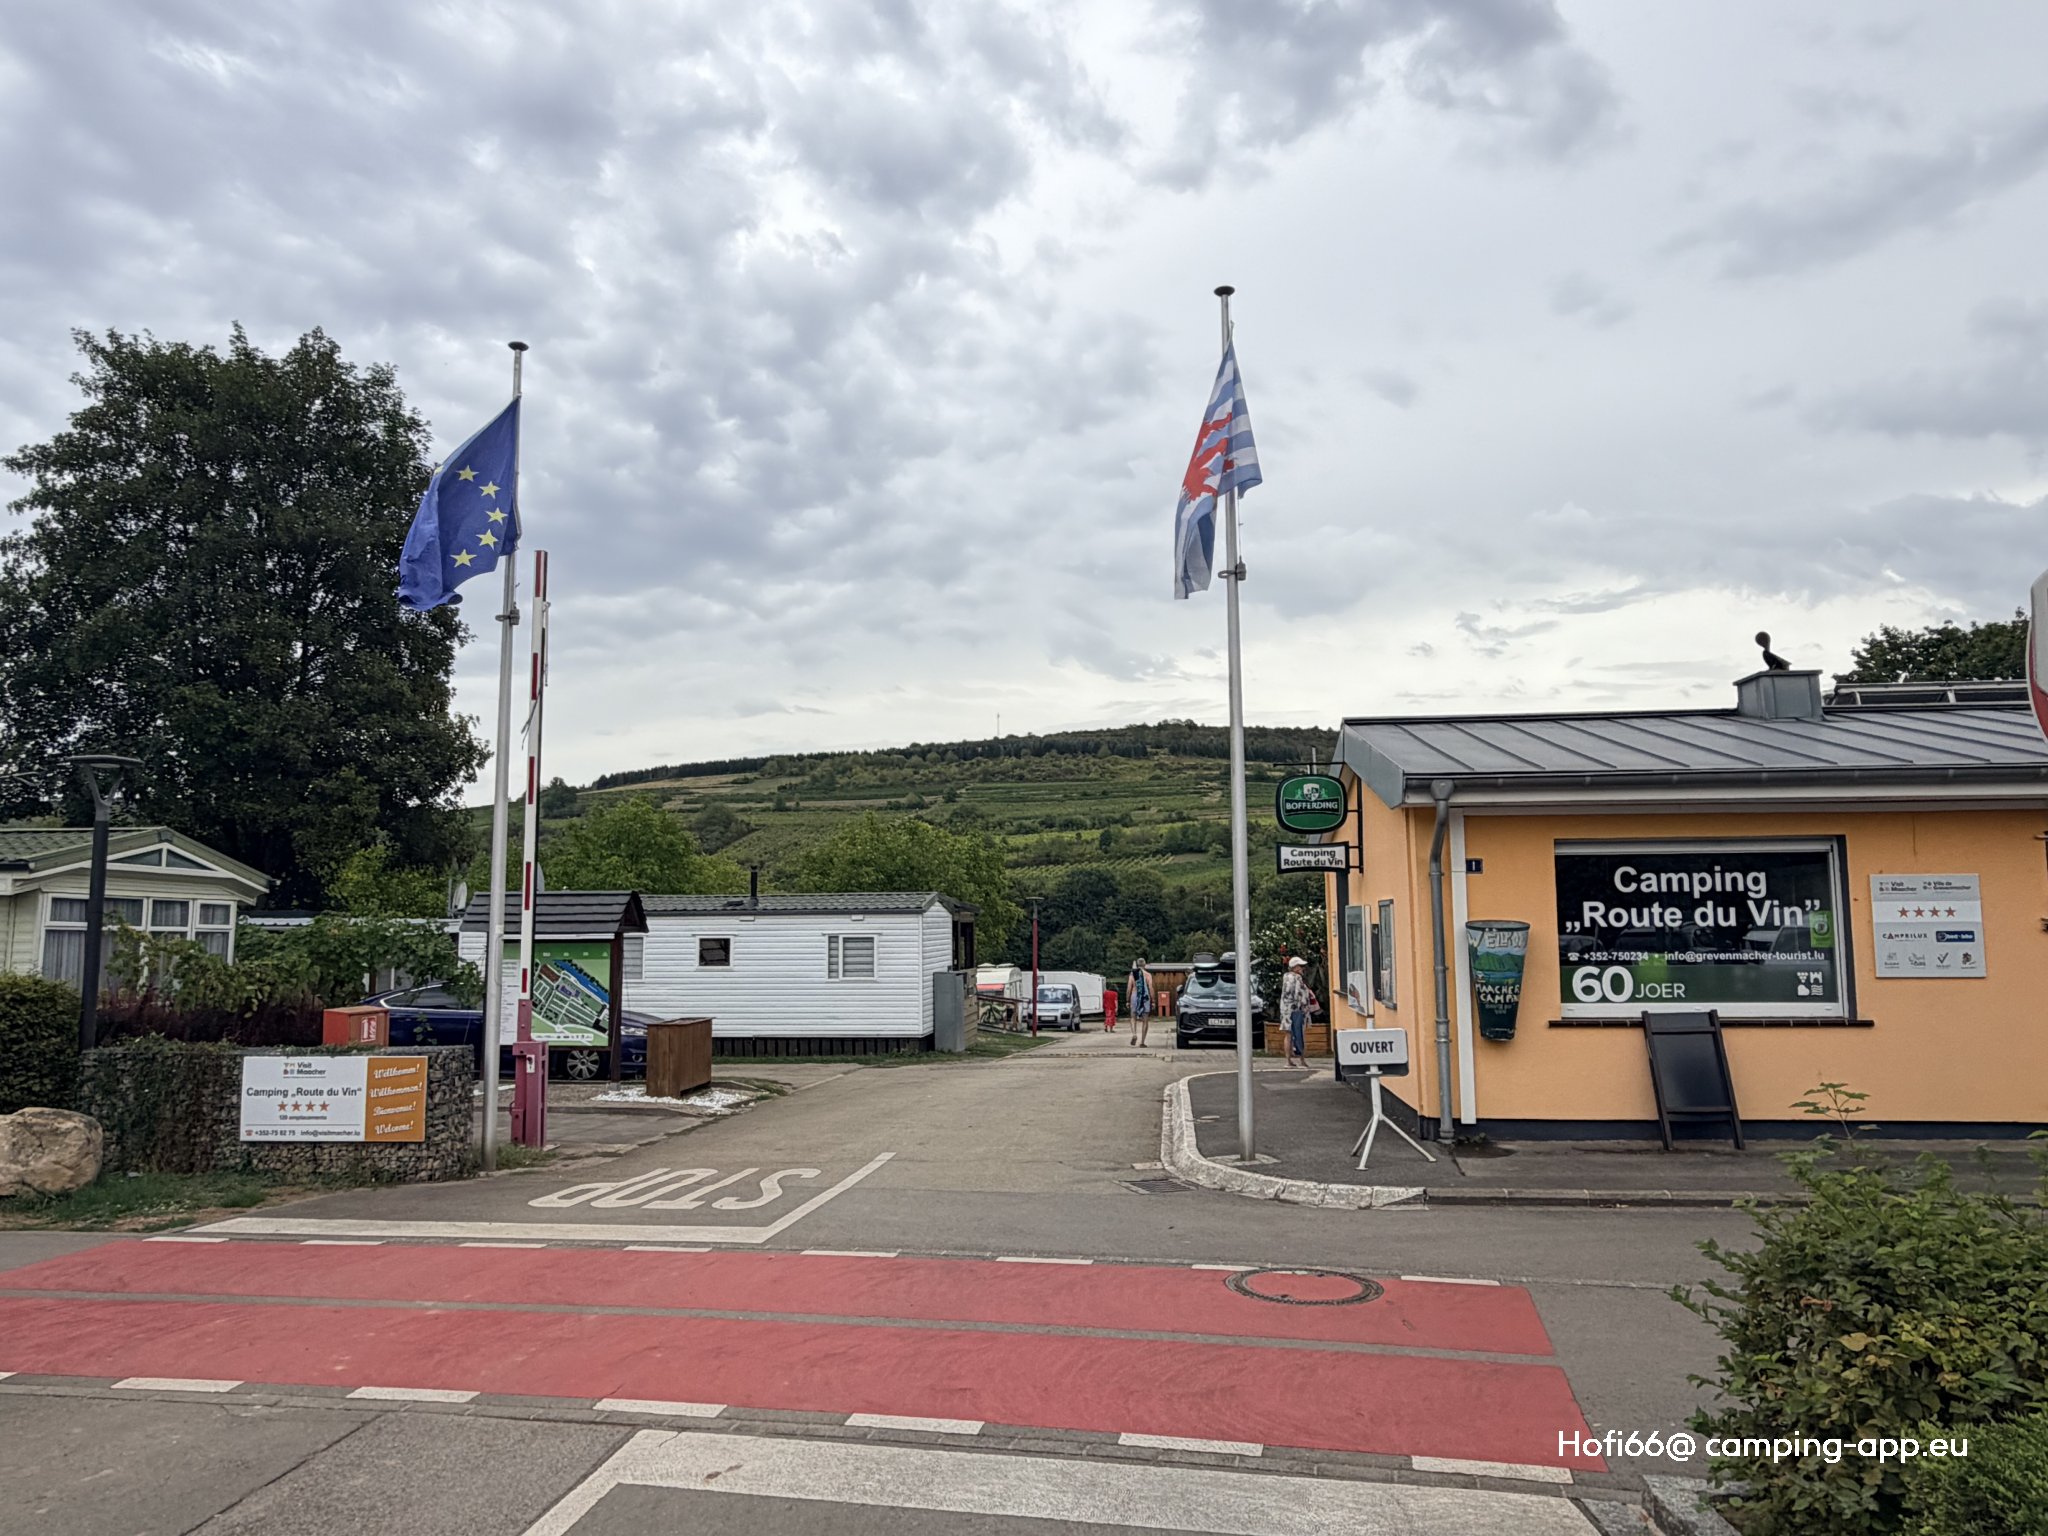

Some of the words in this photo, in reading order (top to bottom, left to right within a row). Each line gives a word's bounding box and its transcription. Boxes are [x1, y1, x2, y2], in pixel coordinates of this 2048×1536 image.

[1286, 801, 1338, 810] BOFFERDING
[1290, 848, 1336, 858] Camping
[1283, 858, 1312, 866] Route
[1314, 858, 1326, 866] du
[1328, 858, 1344, 866] Vin
[1613, 866, 1768, 898] Camping
[1693, 900, 1738, 928] du
[1583, 951, 1649, 962] +352-750234
[1664, 950, 1825, 964] info@grevenmacher-tourist.lu
[1572, 965, 1635, 1003] 60
[1635, 983, 1686, 999] JOER
[1350, 1040, 1394, 1054] OUVERT
[296, 1068, 326, 1076] Maacher
[246, 1088, 288, 1098] Camping
[327, 1088, 339, 1096] du
[374, 1120, 414, 1135] Welcome!
[527, 1167, 822, 1210] STOP
